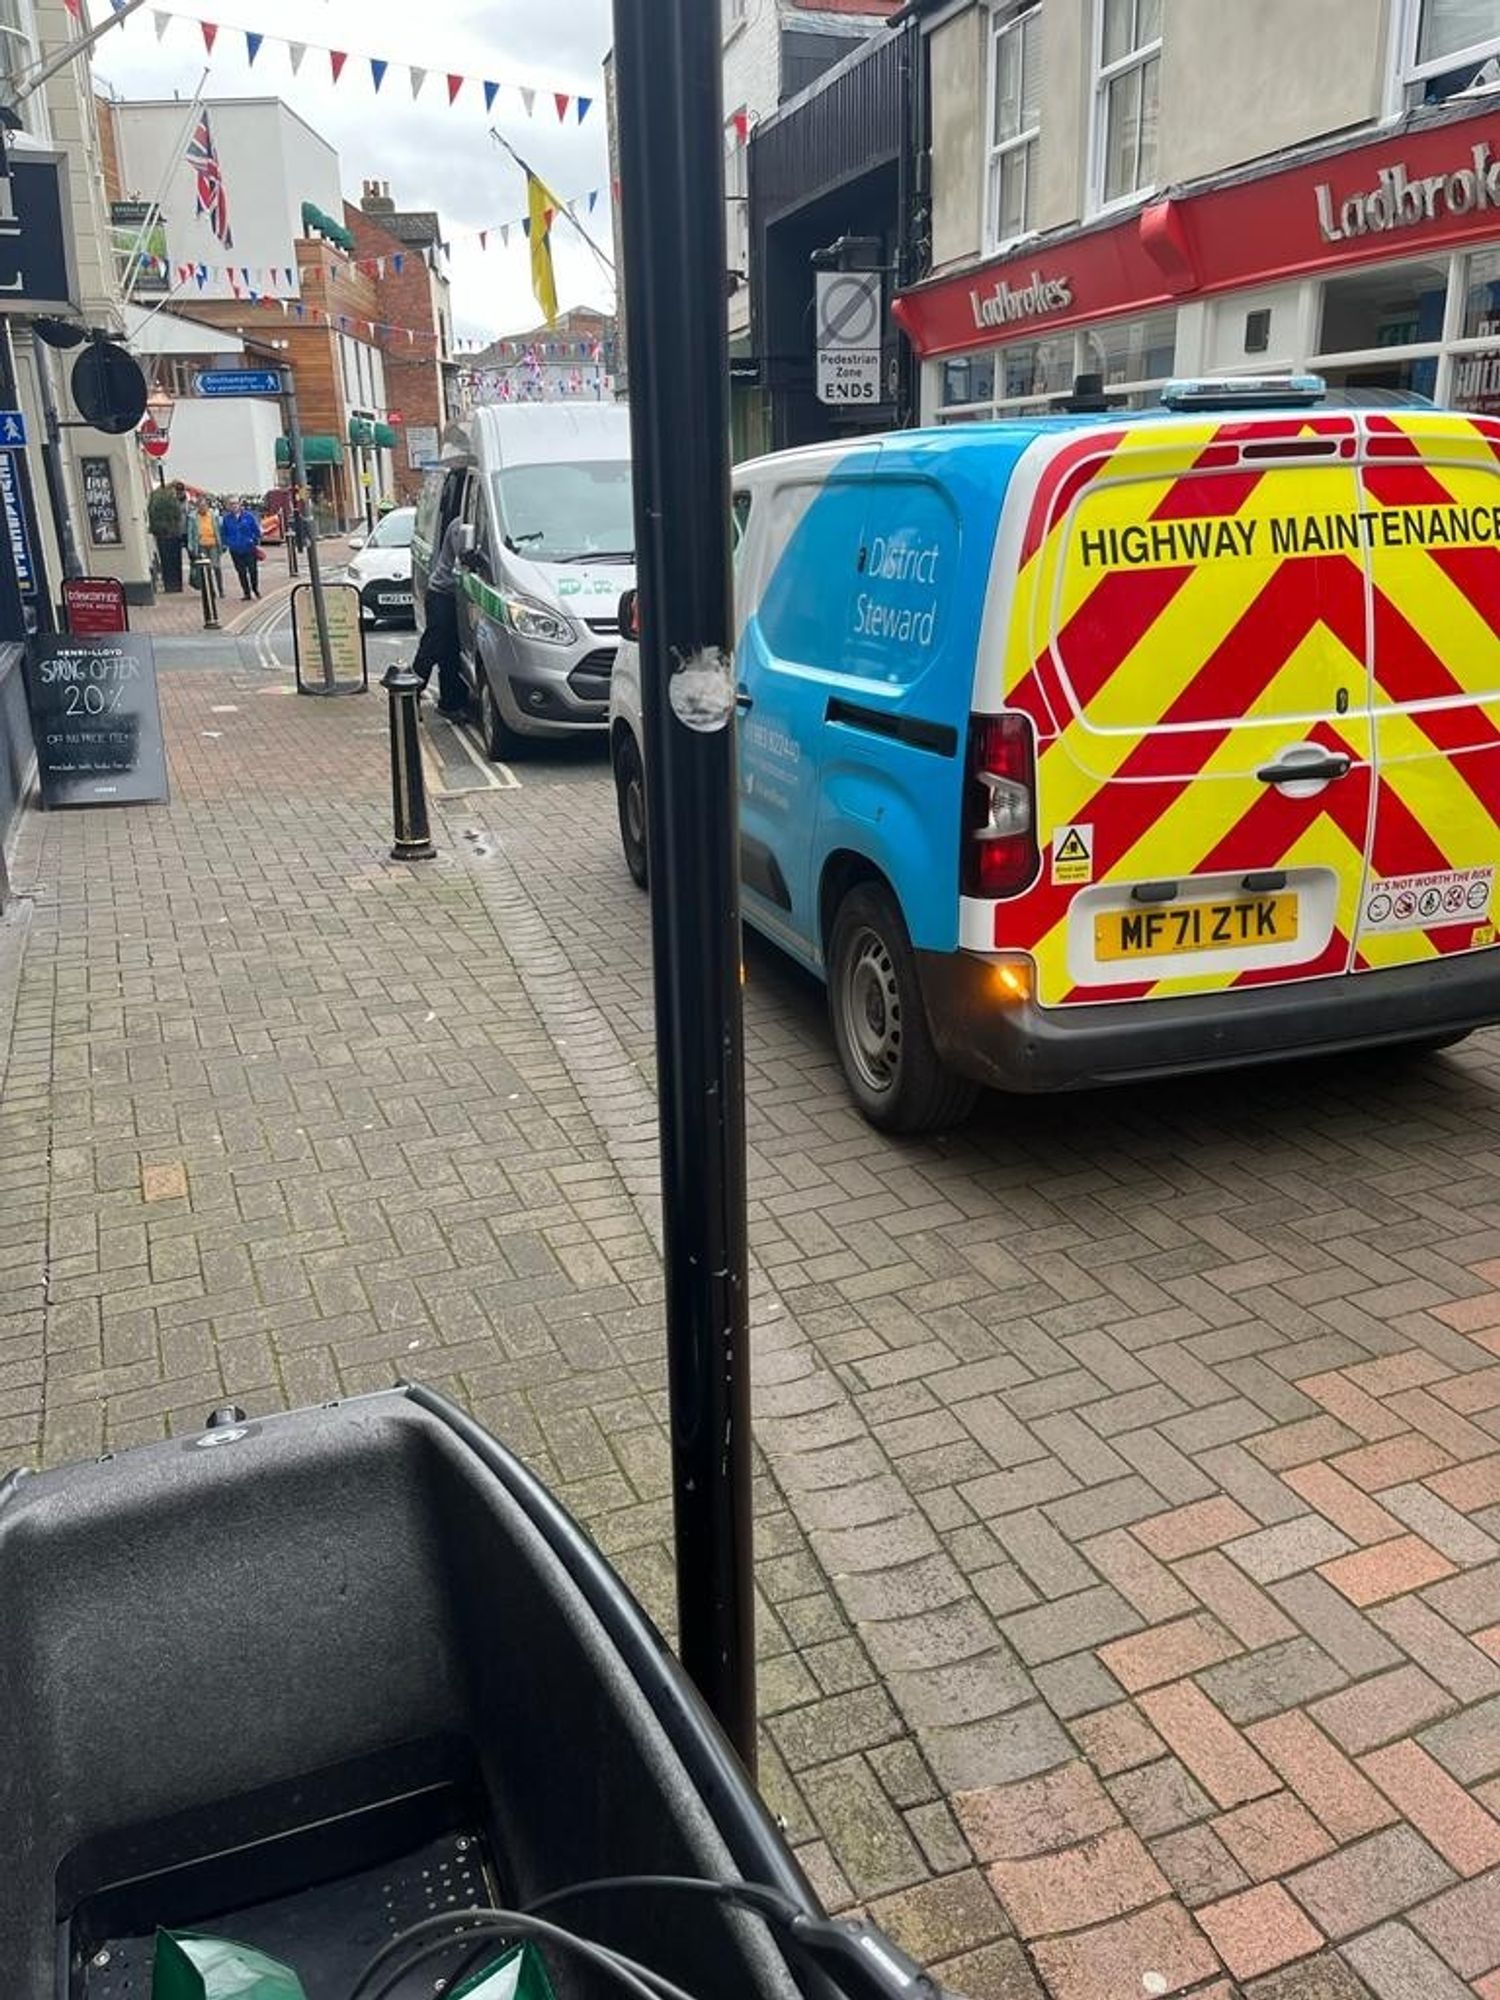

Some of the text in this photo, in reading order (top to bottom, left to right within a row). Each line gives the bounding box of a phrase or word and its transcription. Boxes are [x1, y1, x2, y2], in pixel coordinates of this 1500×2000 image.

[969, 270, 1073, 328] Ladbrokes
[821, 354, 878, 364] Pedestrian
[836, 367, 862, 377] Zone
[206, 376, 257, 384] Southampton
[825, 382, 873, 398] ENDS
[1080, 520, 1257, 566] HIGHWAY
[868, 537, 939, 584] District
[854, 593, 937, 646] Steward
[39, 658, 86, 682] SPRING
[64, 685, 124, 716] 20%
[1371, 868, 1493, 892] IT'S NOT WORTH THE RISK
[1121, 901, 1277, 951] MF71 ZTK
